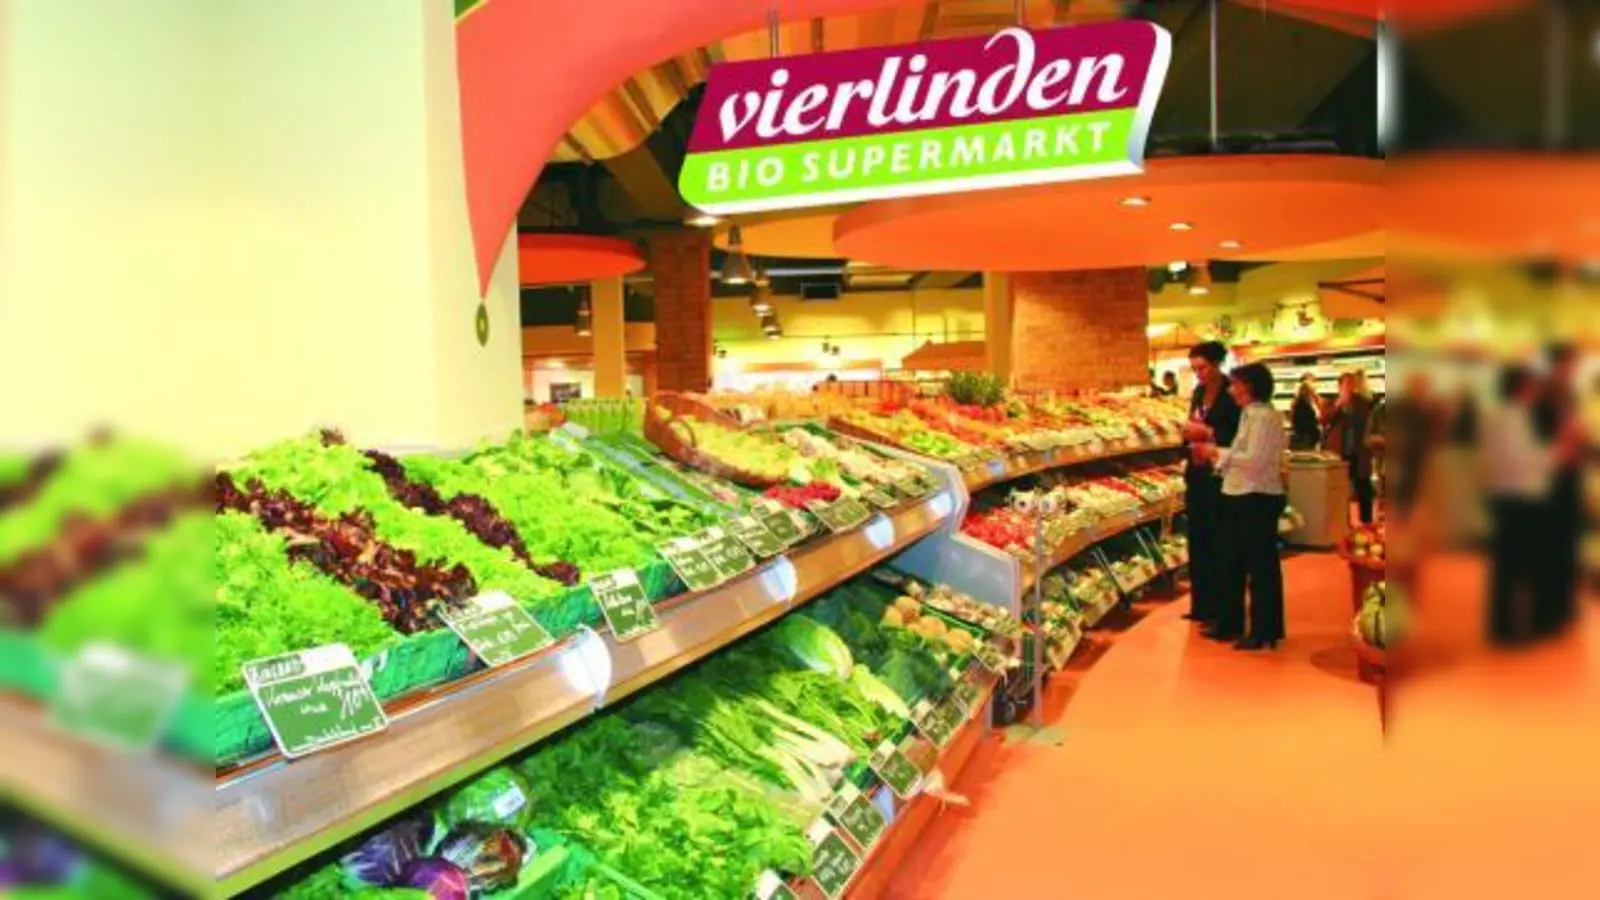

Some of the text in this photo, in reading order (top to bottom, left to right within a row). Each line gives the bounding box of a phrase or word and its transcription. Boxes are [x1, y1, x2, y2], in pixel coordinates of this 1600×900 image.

[718, 27, 1128, 143] vierlinden
[706, 121, 1112, 192] BIO SUPERMARKT
